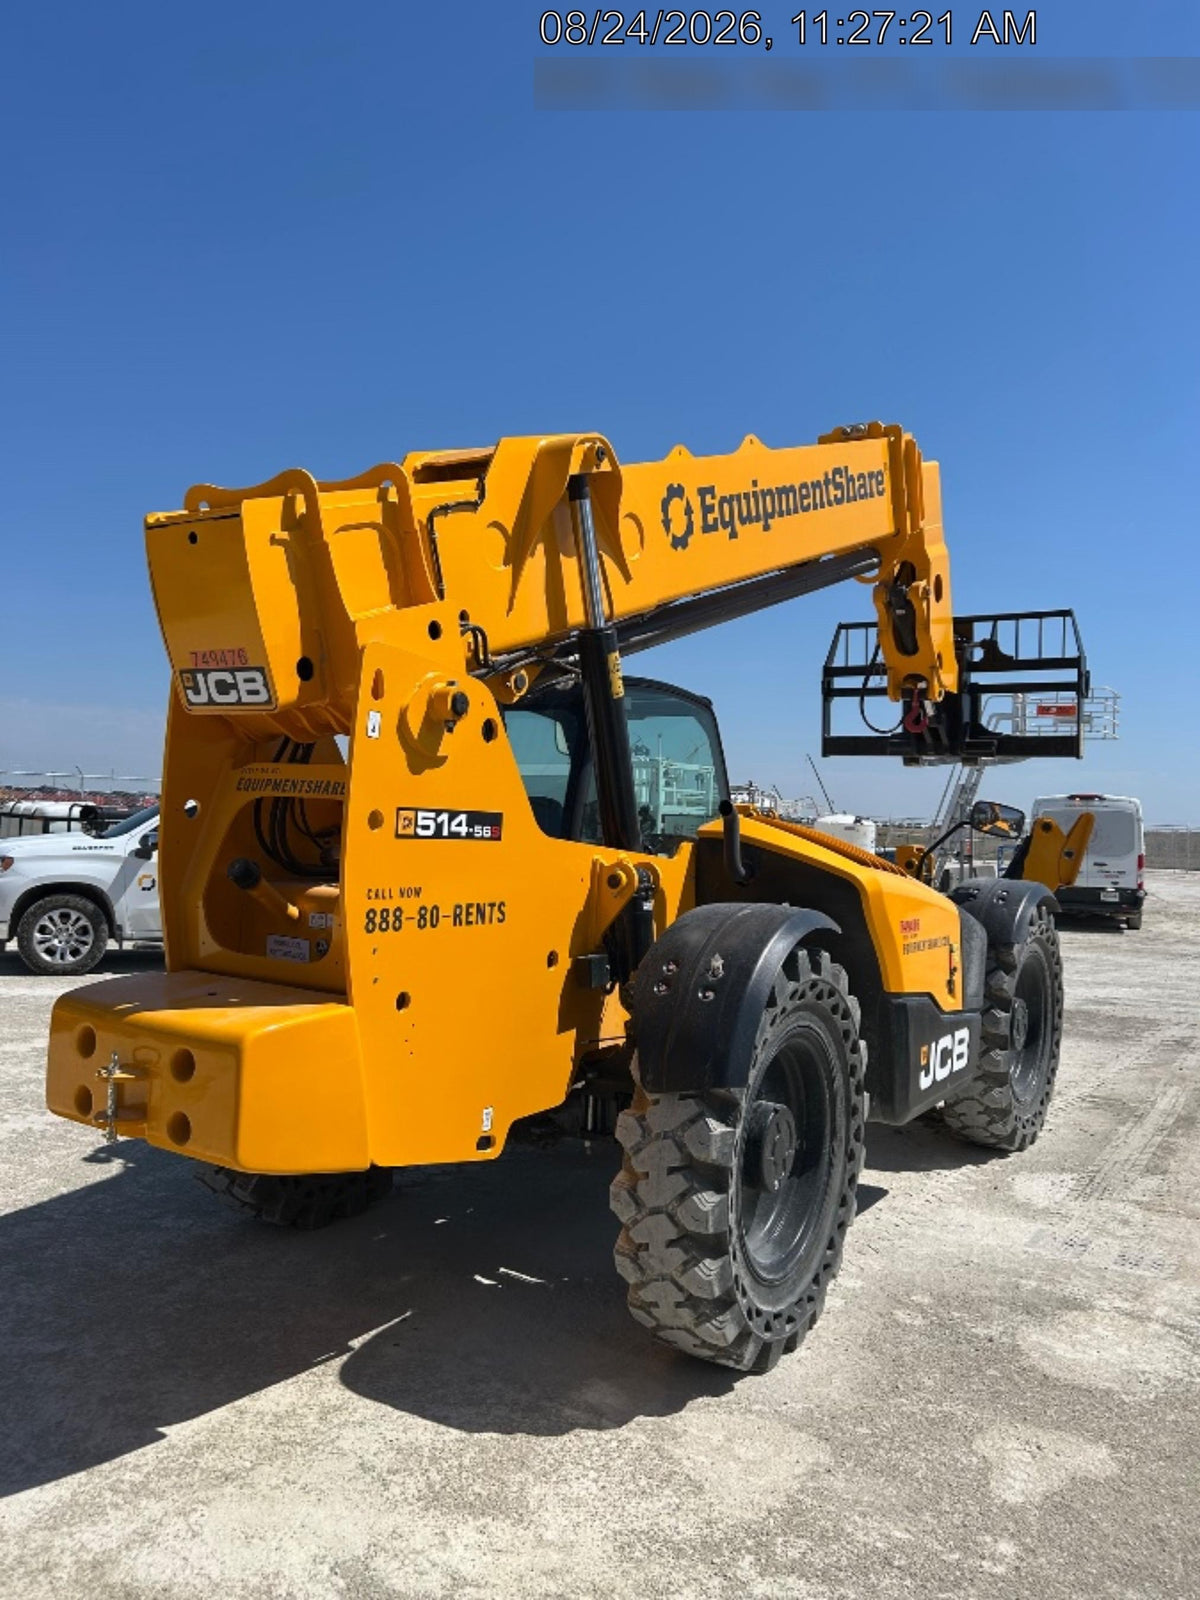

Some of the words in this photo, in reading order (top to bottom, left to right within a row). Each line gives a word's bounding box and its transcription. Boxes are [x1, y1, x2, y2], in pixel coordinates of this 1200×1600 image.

[697, 465, 885, 540] EquipmentShare
[185, 670, 269, 703] JCB
[366, 888, 394, 901] CALL
[399, 886, 423, 899] NOW
[364, 901, 506, 934] 888-80-RENTS
[919, 1026, 970, 1091] JCB
